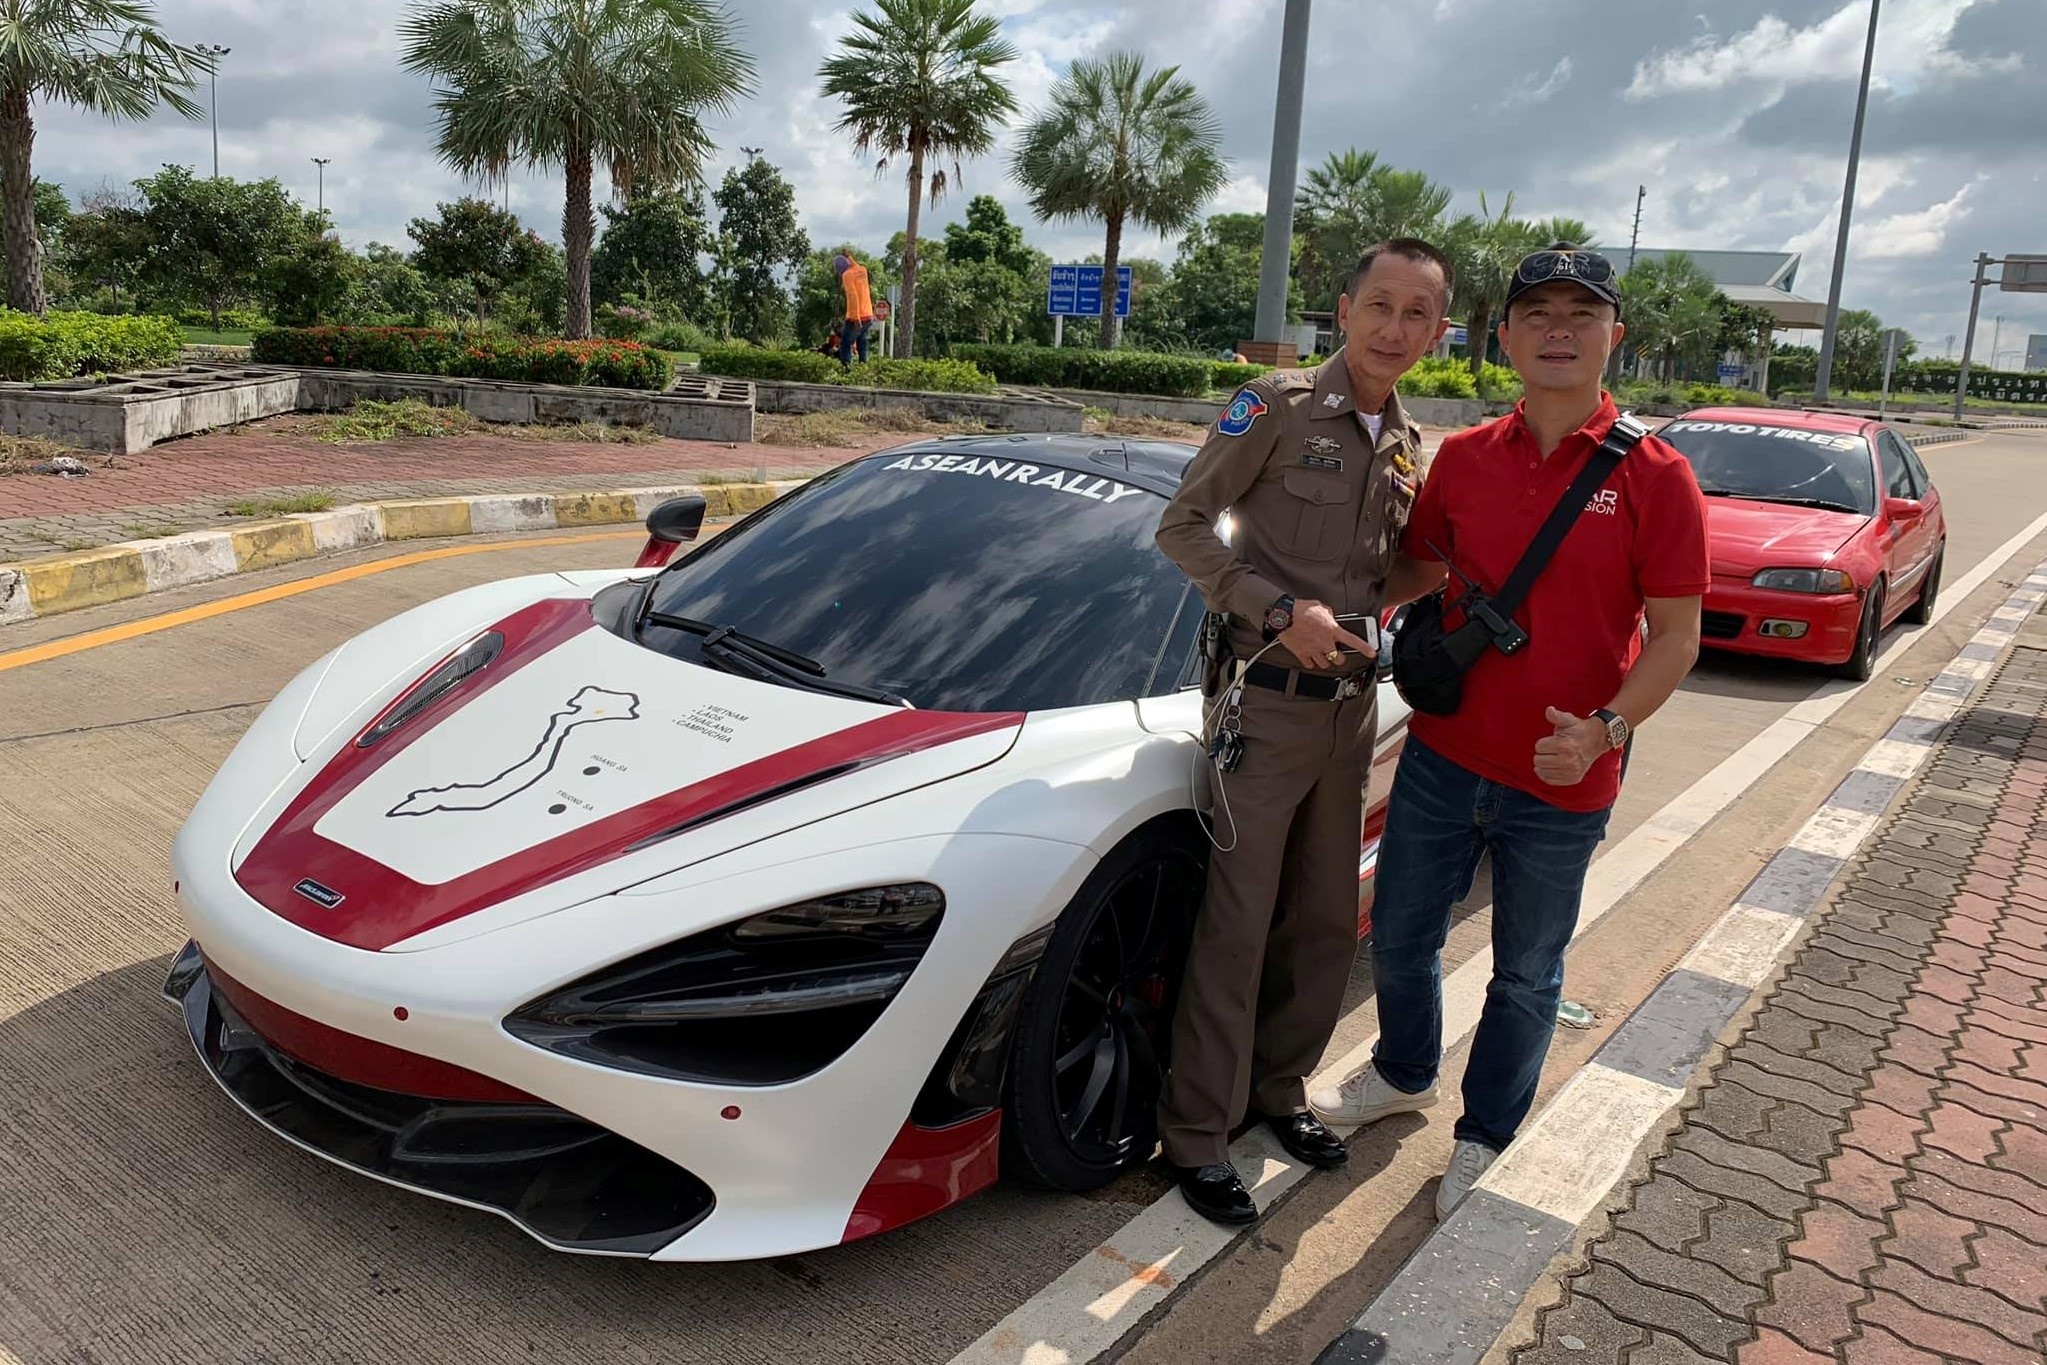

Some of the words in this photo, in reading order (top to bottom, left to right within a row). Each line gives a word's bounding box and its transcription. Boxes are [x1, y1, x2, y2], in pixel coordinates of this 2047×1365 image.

[1670, 422, 1758, 434] TOYO
[1756, 427, 1854, 450] TIRES
[1592, 489, 1617, 505] AR
[1584, 501, 1616, 515] SION
